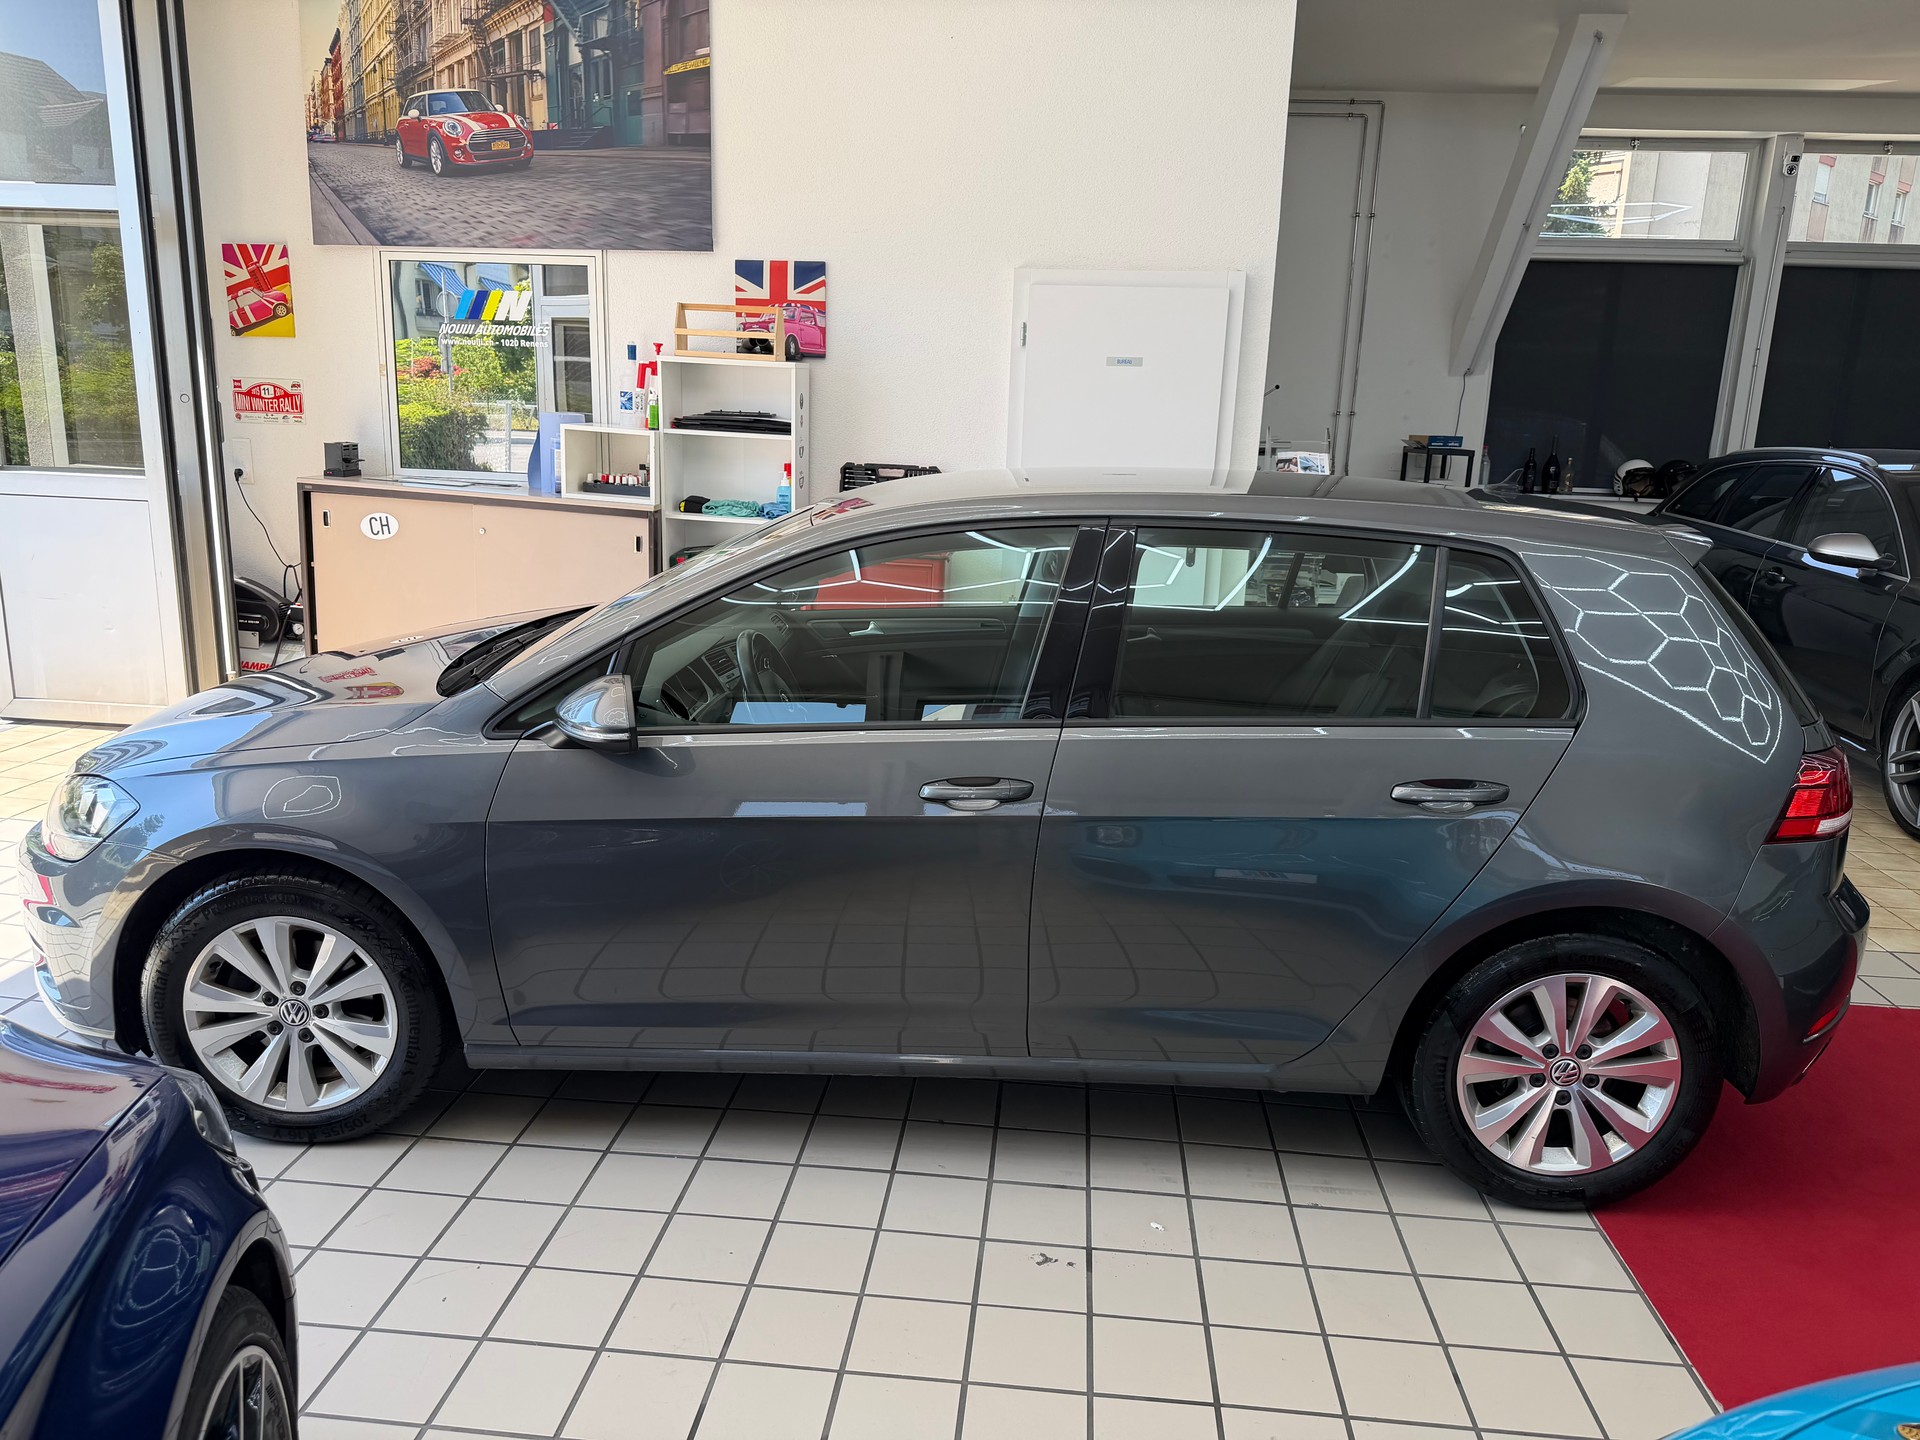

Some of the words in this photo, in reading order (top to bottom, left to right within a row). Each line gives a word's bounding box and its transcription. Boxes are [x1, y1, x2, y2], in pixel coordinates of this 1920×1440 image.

[475, 325, 550, 337] AUTOMOBILES
[501, 338, 519, 347] 1020
[520, 339, 549, 348] Renens
[261, 386, 270, 396] 11
[235, 391, 251, 411] MINI
[251, 396, 278, 412] WINTER
[279, 394, 301, 412] RALLY
[369, 515, 391, 536] CH
